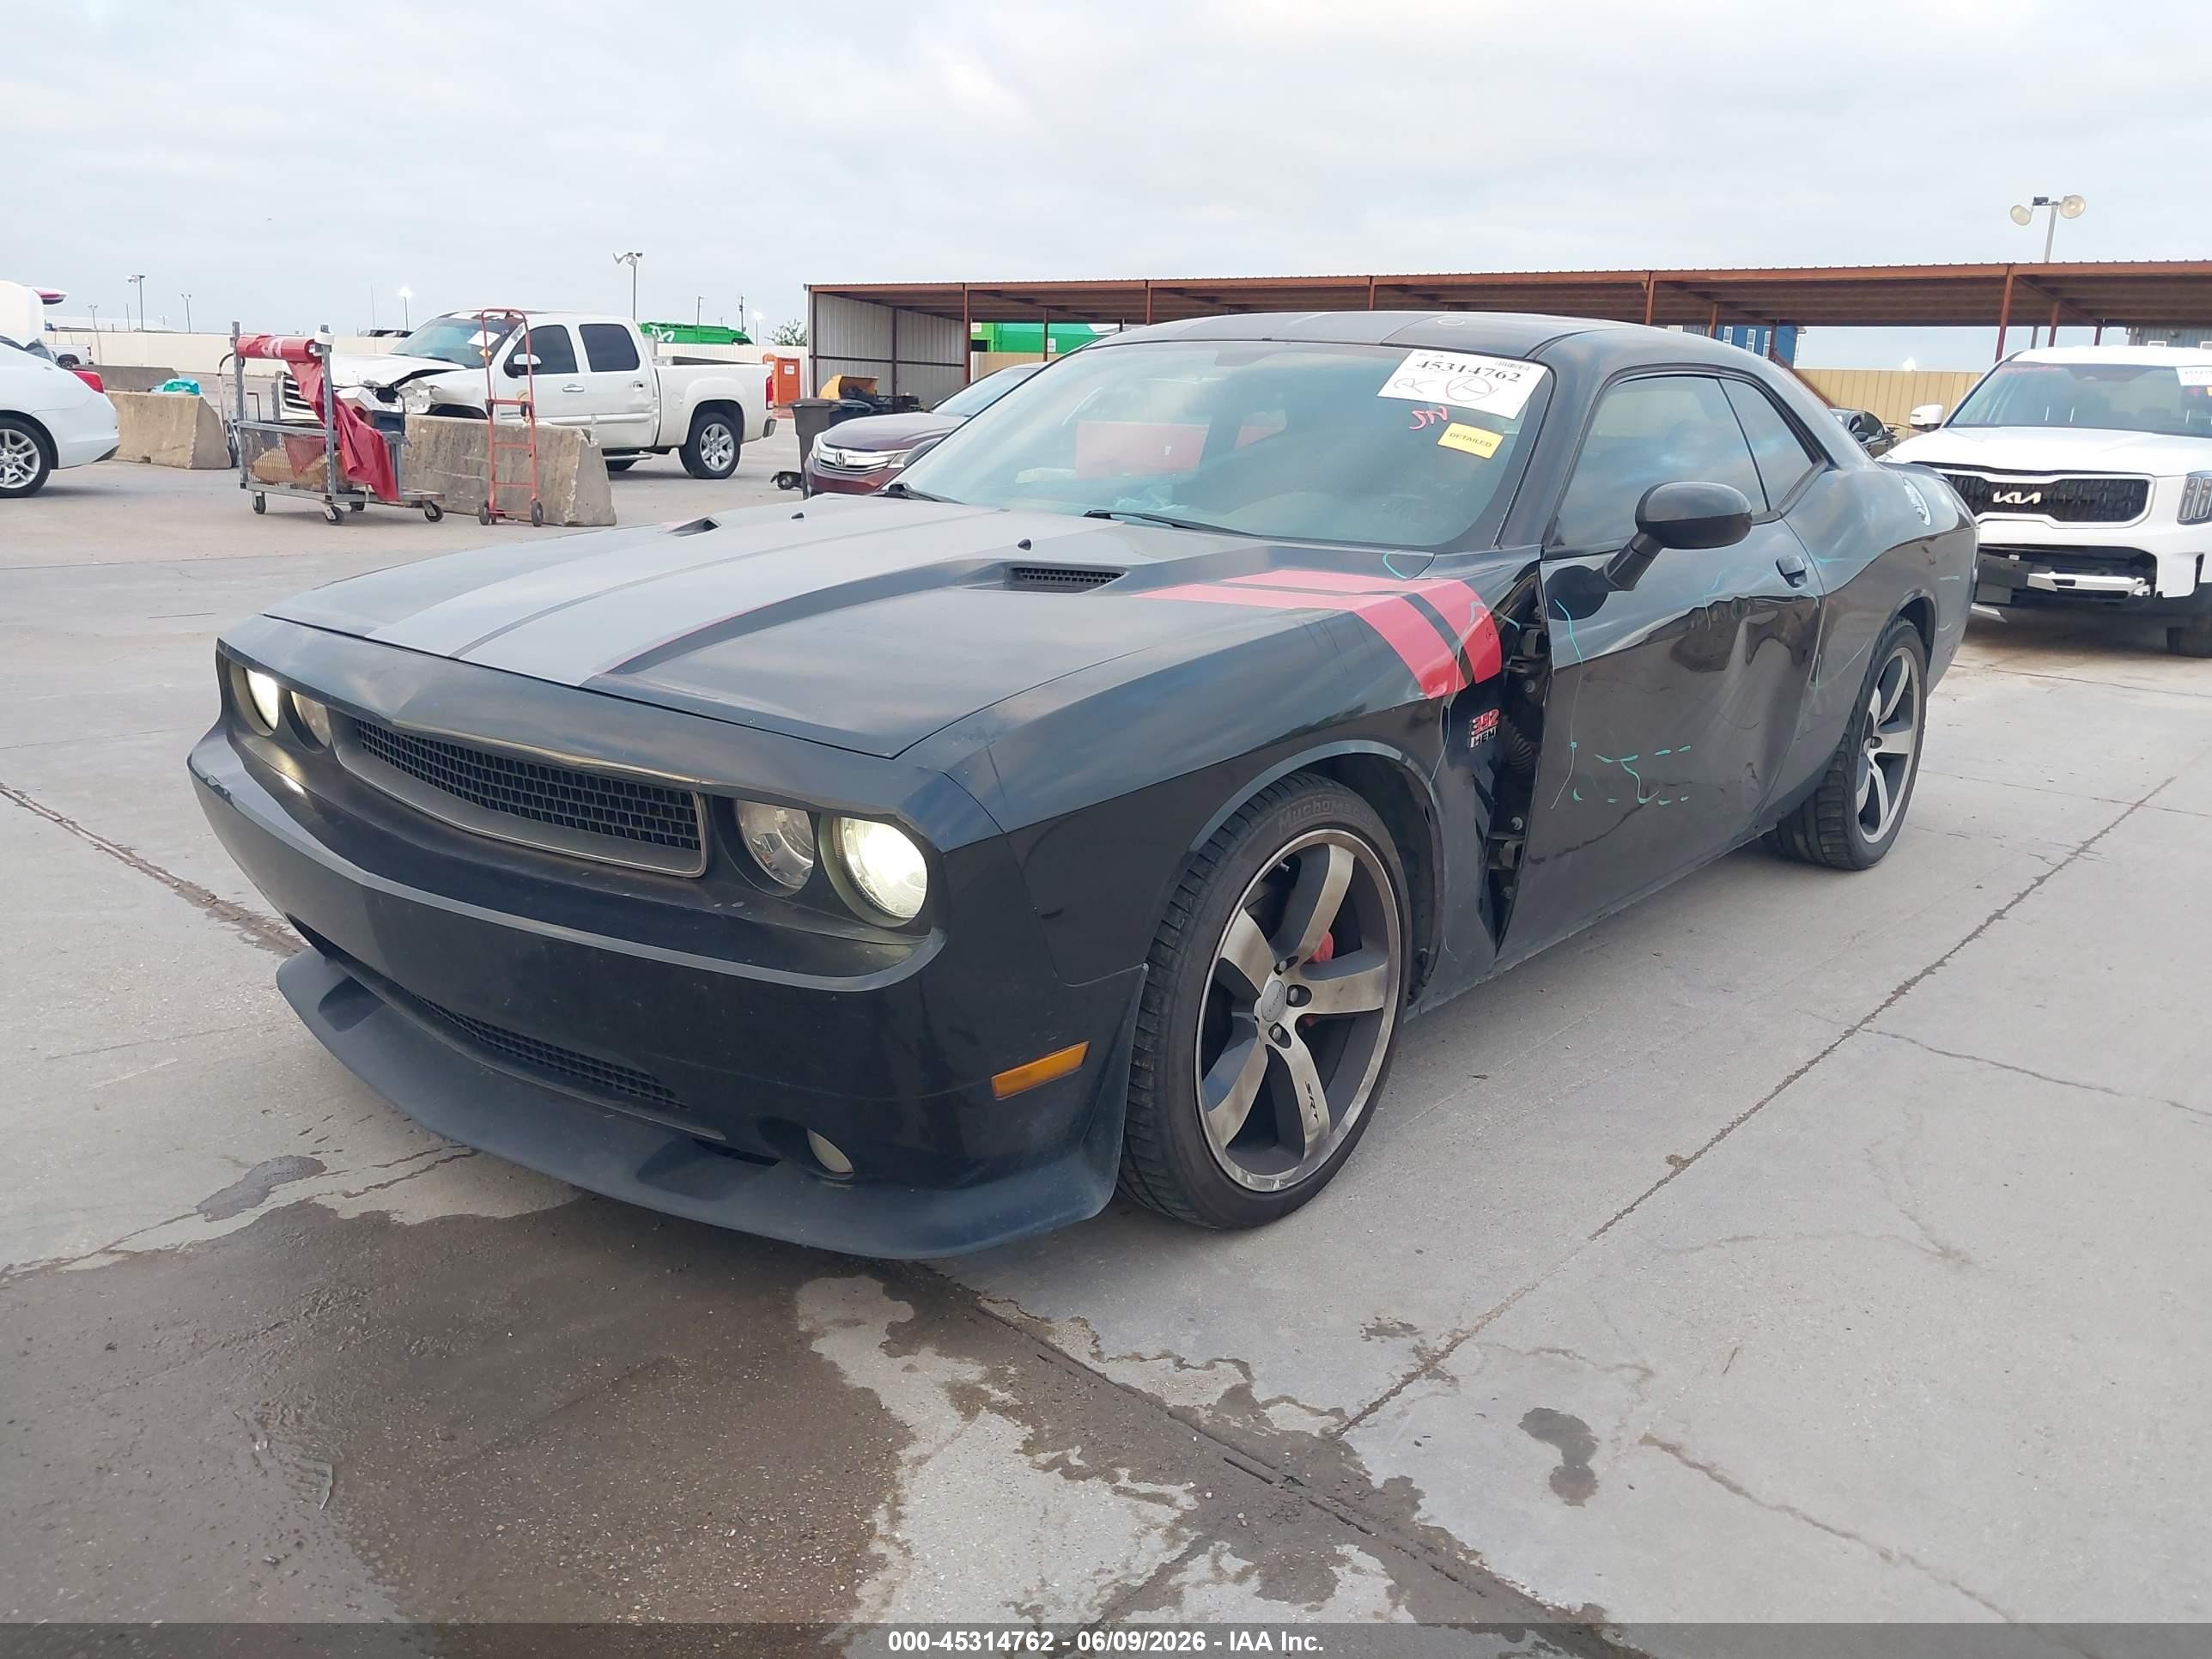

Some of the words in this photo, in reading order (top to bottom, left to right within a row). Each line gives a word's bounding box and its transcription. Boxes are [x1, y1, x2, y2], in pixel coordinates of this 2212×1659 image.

[1416, 360, 1522, 383] 45314762
[1449, 432, 1492, 447] DETAILED
[1993, 490, 2042, 504] KIA
[1471, 708, 1500, 736] 392
[1304, 1079, 1320, 1125] SRT
